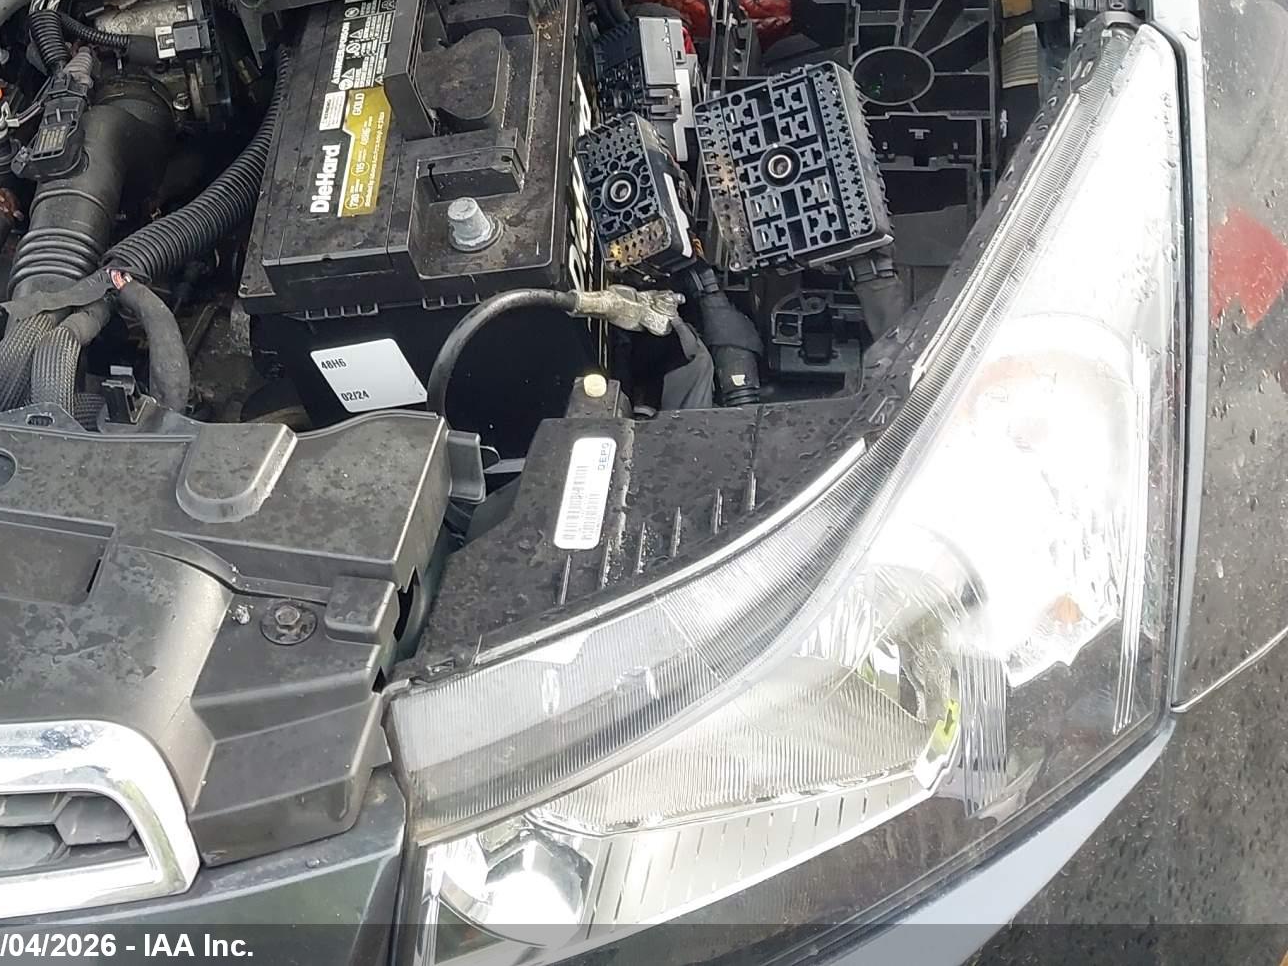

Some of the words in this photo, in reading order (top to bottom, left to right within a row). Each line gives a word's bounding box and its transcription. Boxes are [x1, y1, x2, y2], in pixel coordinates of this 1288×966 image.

[352, 92, 365, 116] GOLD
[310, 144, 340, 213] DieHard
[569, 72, 592, 292] DieHrd
[321, 358, 347, 370] 48H6
[341, 390, 369, 402] 02/24
[598, 442, 609, 471] DEPO
